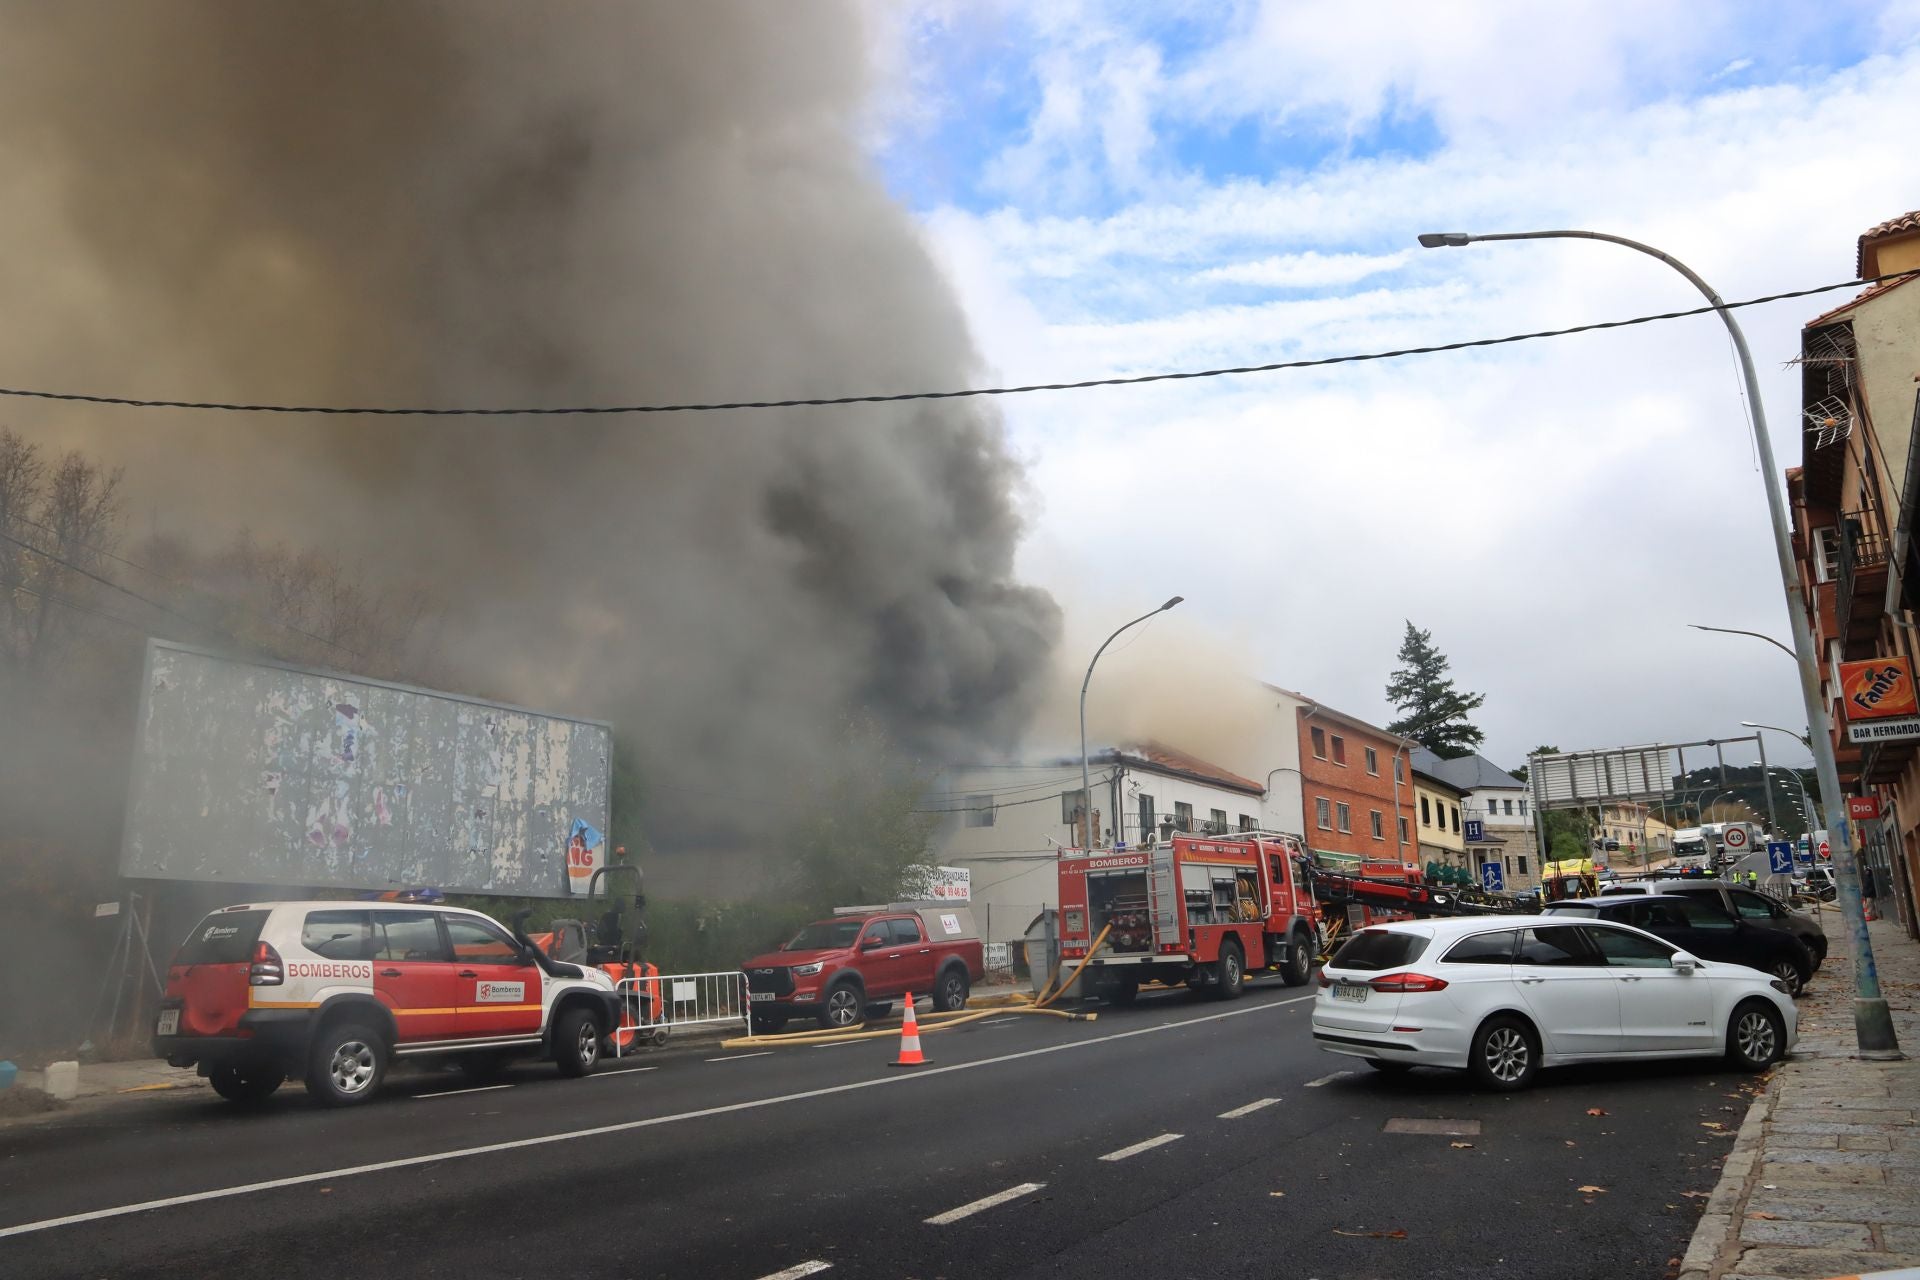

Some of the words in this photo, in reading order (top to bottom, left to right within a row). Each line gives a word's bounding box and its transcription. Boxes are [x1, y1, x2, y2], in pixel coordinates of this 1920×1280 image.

[1853, 666, 1903, 710] Fanta
[1853, 728, 1871, 739] BAR
[1873, 723, 1920, 737] HERNANDO
[1468, 823, 1479, 835] H
[1089, 857, 1144, 868] BOMBEROS
[288, 963, 371, 979] BOMBEROS
